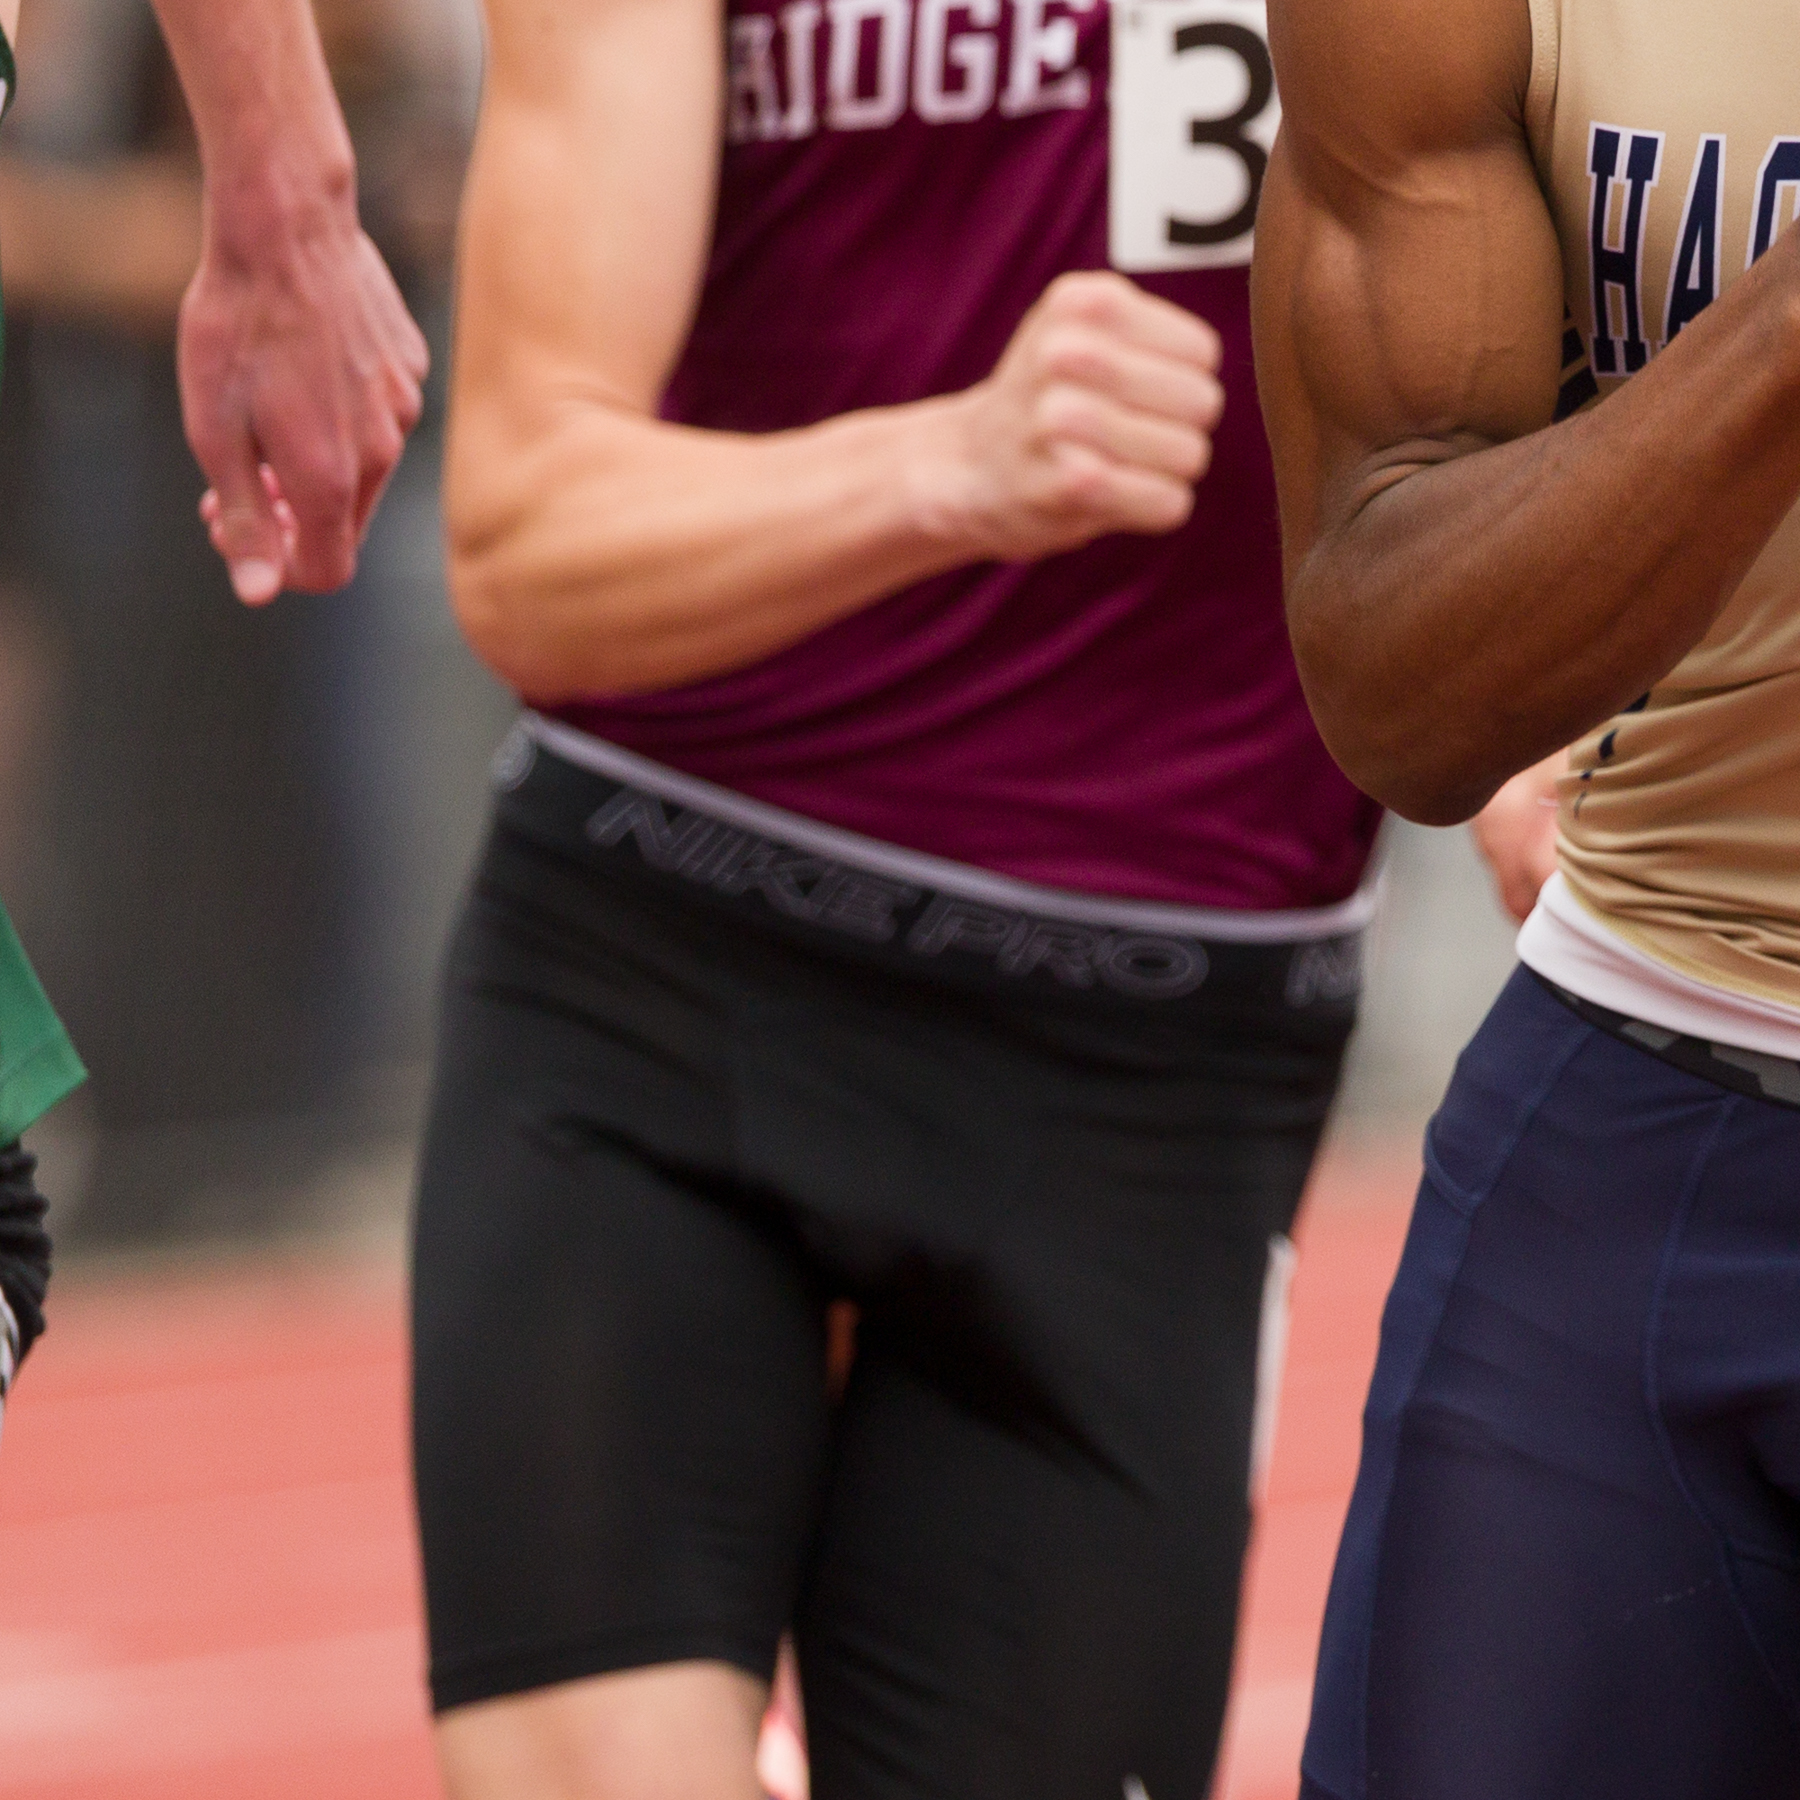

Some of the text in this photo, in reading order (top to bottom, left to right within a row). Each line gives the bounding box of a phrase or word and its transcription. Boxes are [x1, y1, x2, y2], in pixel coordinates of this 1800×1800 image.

[1169, 23, 1273, 244] 3
[585, 788, 908, 946] NIKE
[906, 895, 1212, 1000] PRO
